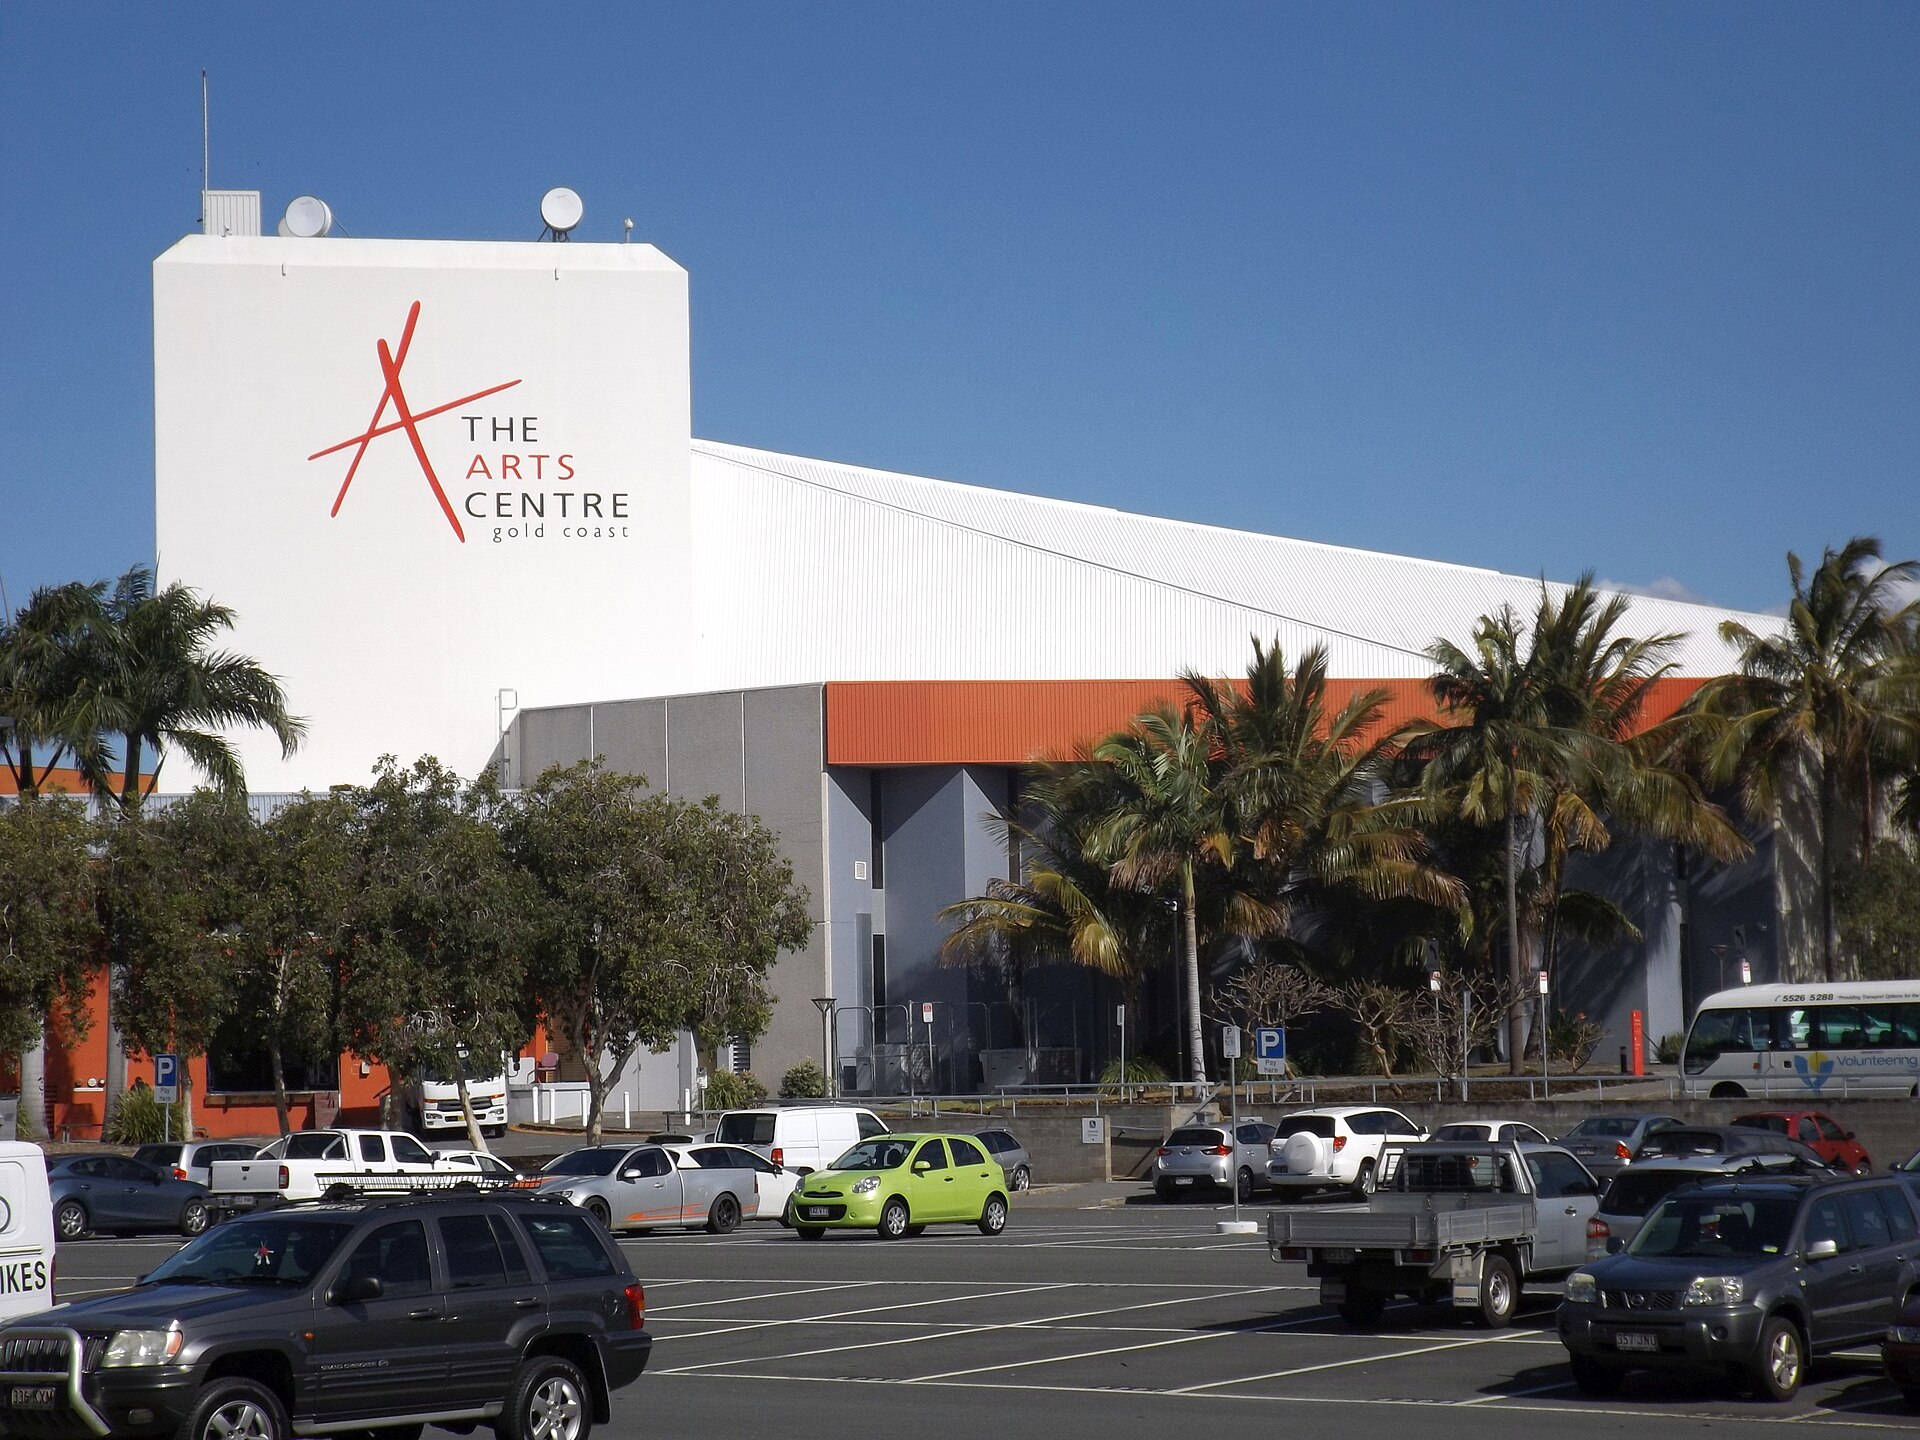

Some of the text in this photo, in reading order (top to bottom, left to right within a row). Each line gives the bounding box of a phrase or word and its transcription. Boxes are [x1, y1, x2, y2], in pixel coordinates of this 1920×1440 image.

[461, 416, 538, 442] THE
[466, 454, 575, 480] ARTS
[464, 492, 629, 518] CENTRE
[492, 523, 629, 543] gold coast
[1782, 993, 1834, 1002] 5526 5288
[1261, 1031, 1280, 1057] P
[157, 1057, 173, 1084] P
[1837, 1055, 1918, 1068] Volunteering
[0, 1260, 46, 1295] IKES
